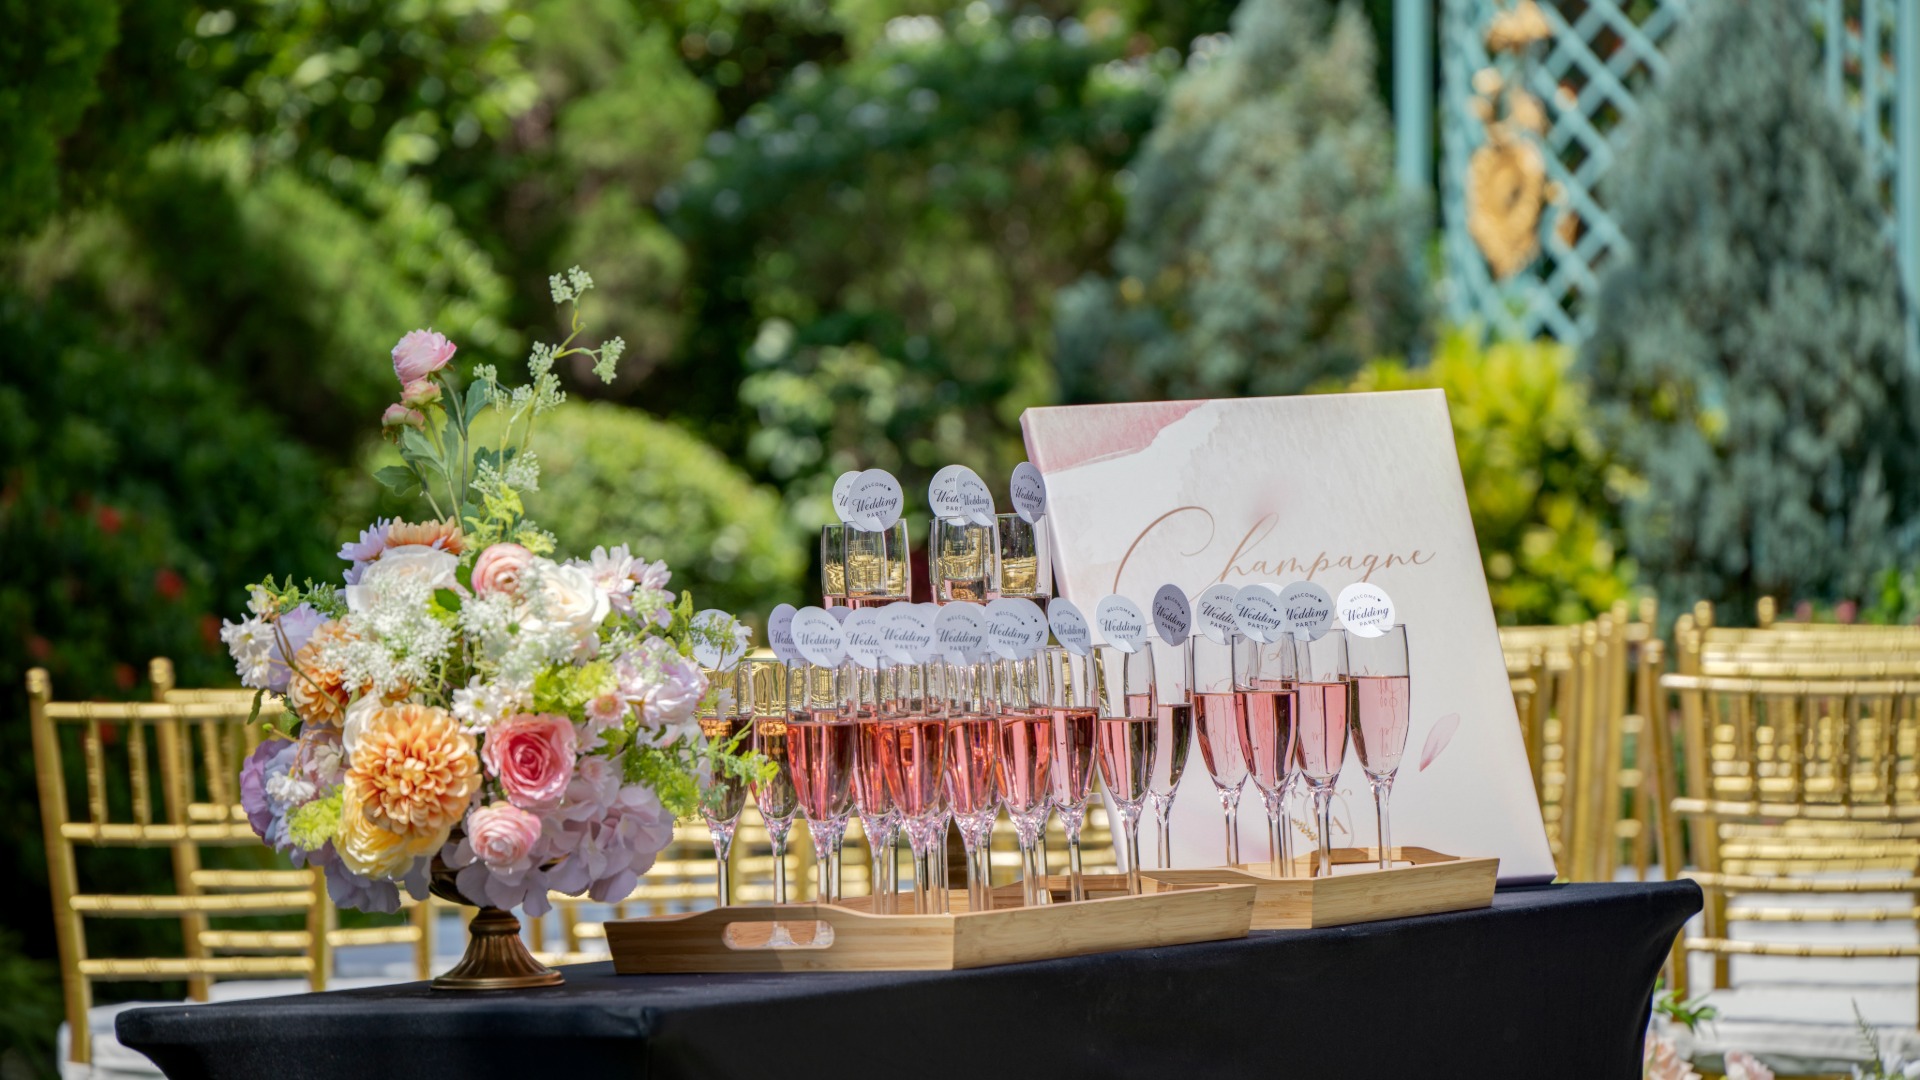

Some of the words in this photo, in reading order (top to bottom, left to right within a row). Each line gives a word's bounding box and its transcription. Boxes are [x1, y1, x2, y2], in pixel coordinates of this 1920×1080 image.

[861, 482, 887, 492] WELCOME
[960, 493, 990, 510] Wedding
[1014, 484, 1043, 507] Wedding
[852, 496, 898, 513] Wedding
[866, 510, 888, 518] PARTY
[1112, 505, 1436, 622] Champagne
[1164, 595, 1183, 610] WELCOME
[1247, 596, 1273, 608] WELCOME
[1289, 593, 1317, 601] WELCOME
[1350, 593, 1376, 602] WELCOME
[995, 611, 1021, 621] WELCOME
[1106, 606, 1131, 615] WELCOME
[1155, 602, 1187, 632] Wedding
[1236, 603, 1281, 630] Wedding
[1285, 606, 1329, 621] Wedding
[1343, 606, 1389, 622] Wedding
[804, 619, 829, 627] WELCOME
[891, 615, 920, 624] WELCOME
[946, 615, 973, 624] WELCOME
[1100, 618, 1142, 636] Wedding
[1210, 620, 1231, 631] PARTY
[1247, 622, 1269, 631] PARTY
[986, 621, 1030, 644] Wedding
[1054, 621, 1086, 639] Wedding
[1161, 622, 1177, 633] PARTY
[797, 632, 840, 649] Wedding
[880, 626, 930, 647] Wedding
[937, 628, 982, 648] Wedding
